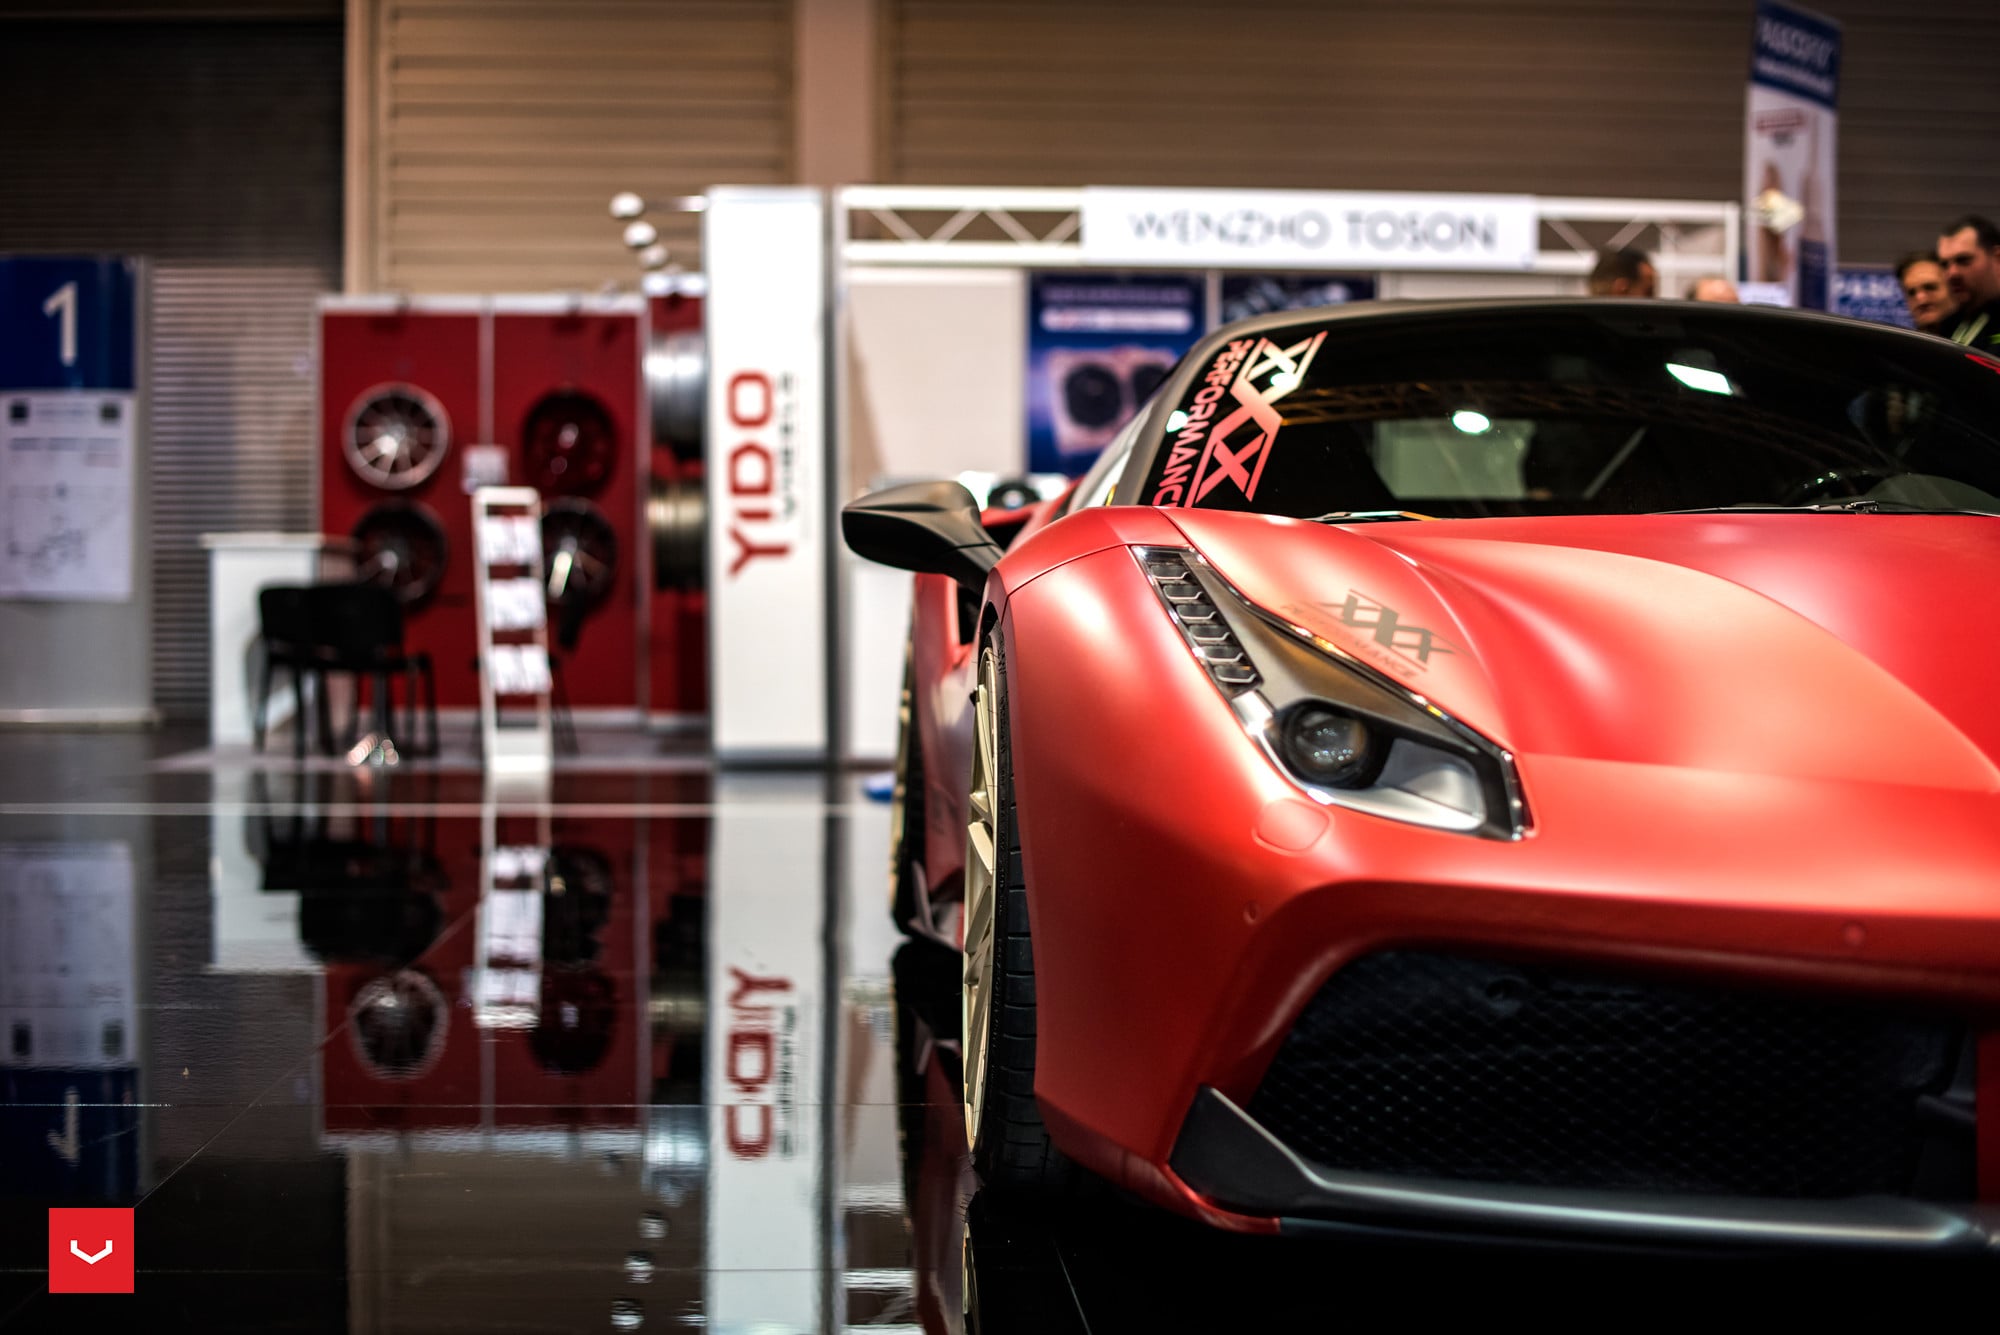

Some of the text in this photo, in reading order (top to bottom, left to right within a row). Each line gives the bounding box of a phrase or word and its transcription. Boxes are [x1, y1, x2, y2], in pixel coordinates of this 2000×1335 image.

[1343, 209, 1498, 252] TOSON
[43, 282, 78, 366] 1
[727, 370, 790, 577] YIDO
